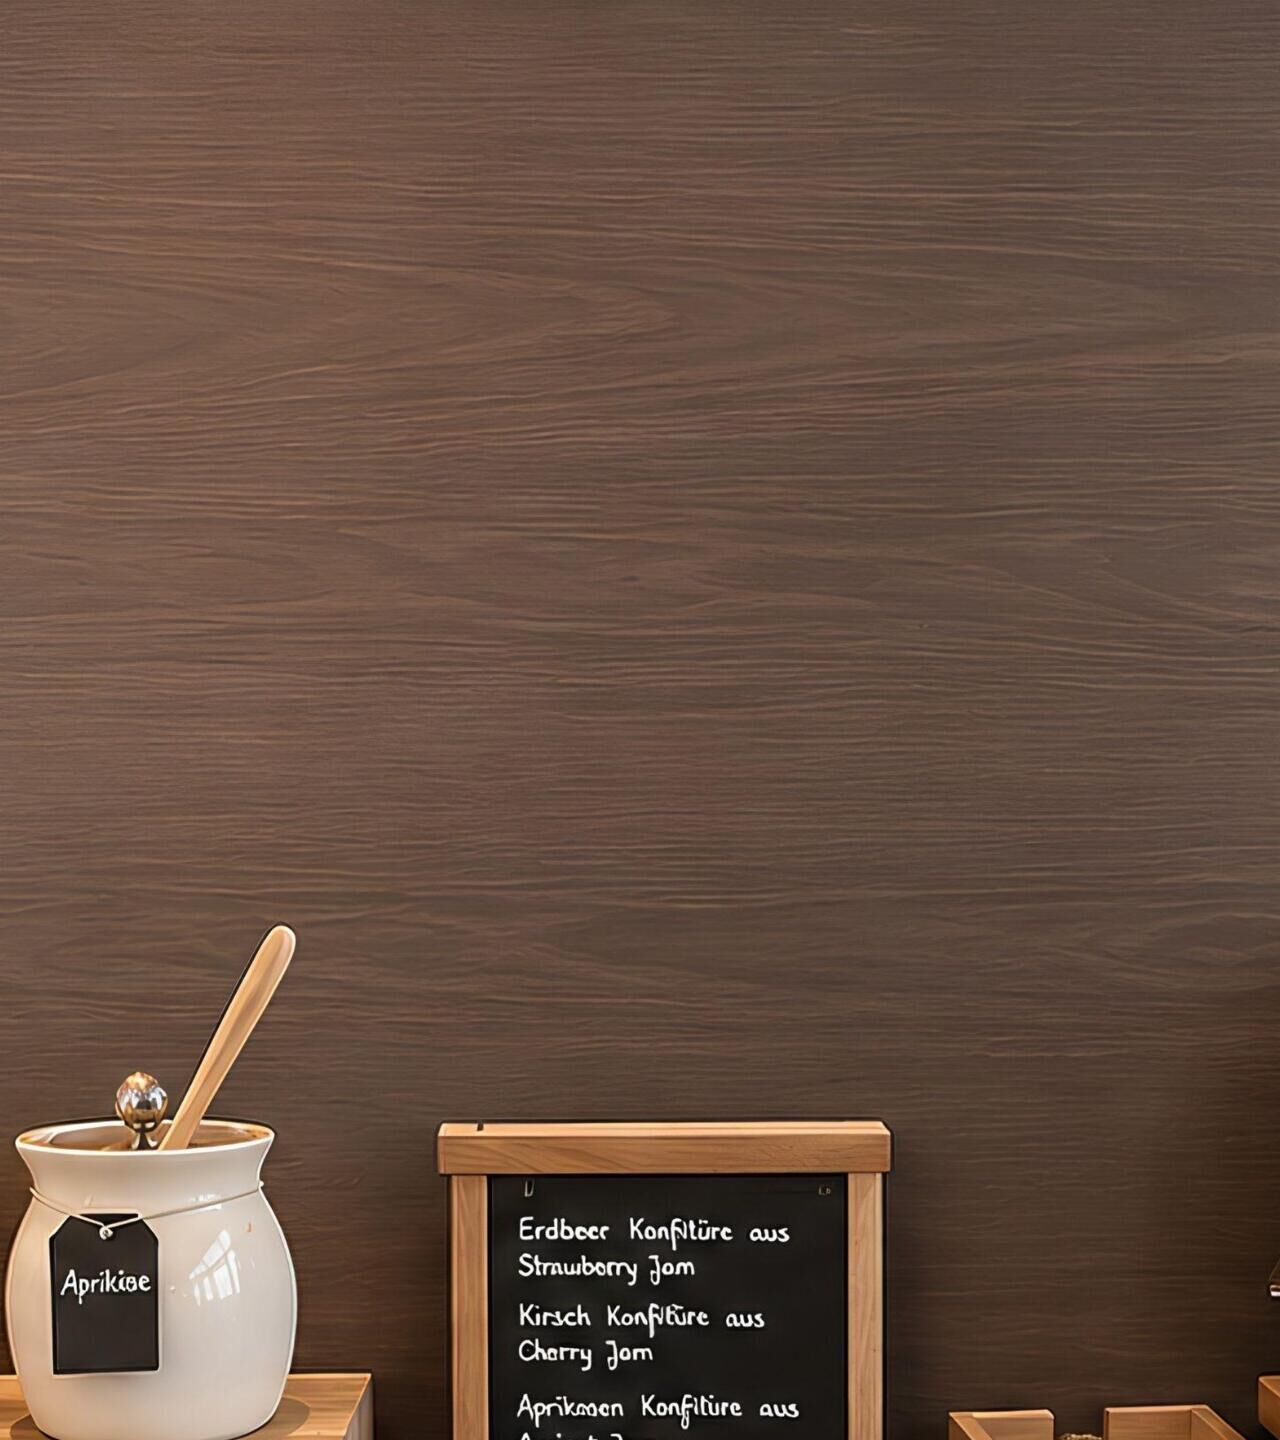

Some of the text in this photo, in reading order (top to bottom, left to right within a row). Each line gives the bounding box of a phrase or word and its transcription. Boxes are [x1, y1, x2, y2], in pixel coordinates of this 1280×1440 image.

[519, 1216, 610, 1241] Erdbeer
[749, 1227, 790, 1243] aus
[519, 1303, 592, 1327] Kirsch
[725, 1312, 765, 1328] aus
[759, 1403, 800, 1418] aus
